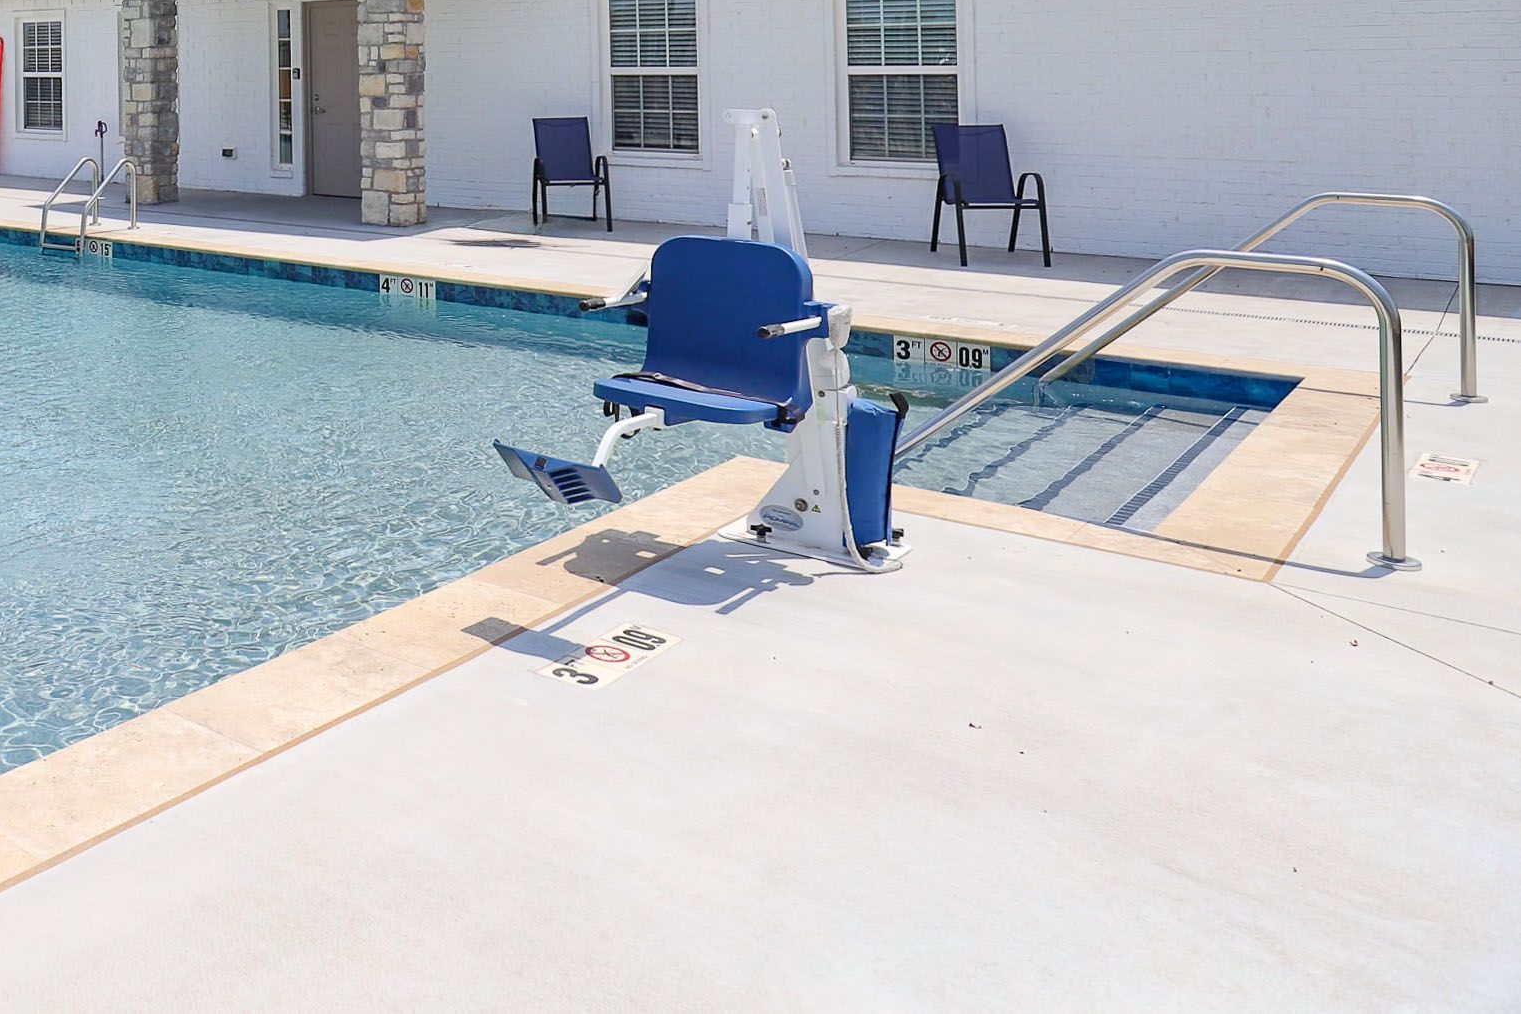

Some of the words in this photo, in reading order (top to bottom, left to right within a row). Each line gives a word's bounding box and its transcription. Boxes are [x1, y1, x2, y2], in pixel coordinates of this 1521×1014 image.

[381, 277, 391, 294] 4
[896, 339, 911, 360] 3
[911, 340, 922, 349] FT
[552, 667, 600, 685] 3
